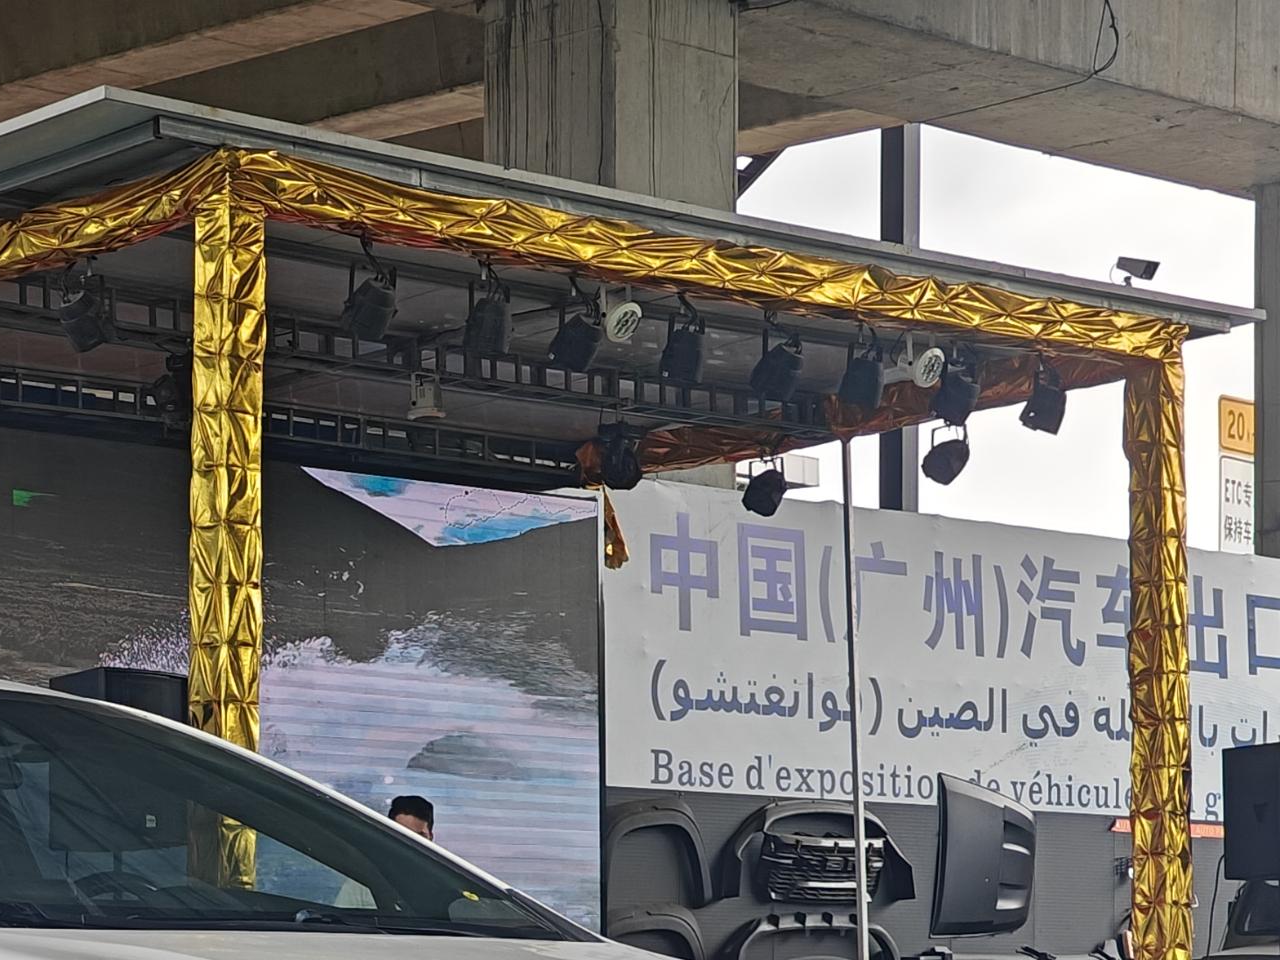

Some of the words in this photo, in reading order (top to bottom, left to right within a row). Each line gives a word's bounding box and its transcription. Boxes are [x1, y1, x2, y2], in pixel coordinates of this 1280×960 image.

[897, 687, 1007, 739] الصين
[1022, 689, 1080, 748] في
[651, 749, 734, 789] Base
